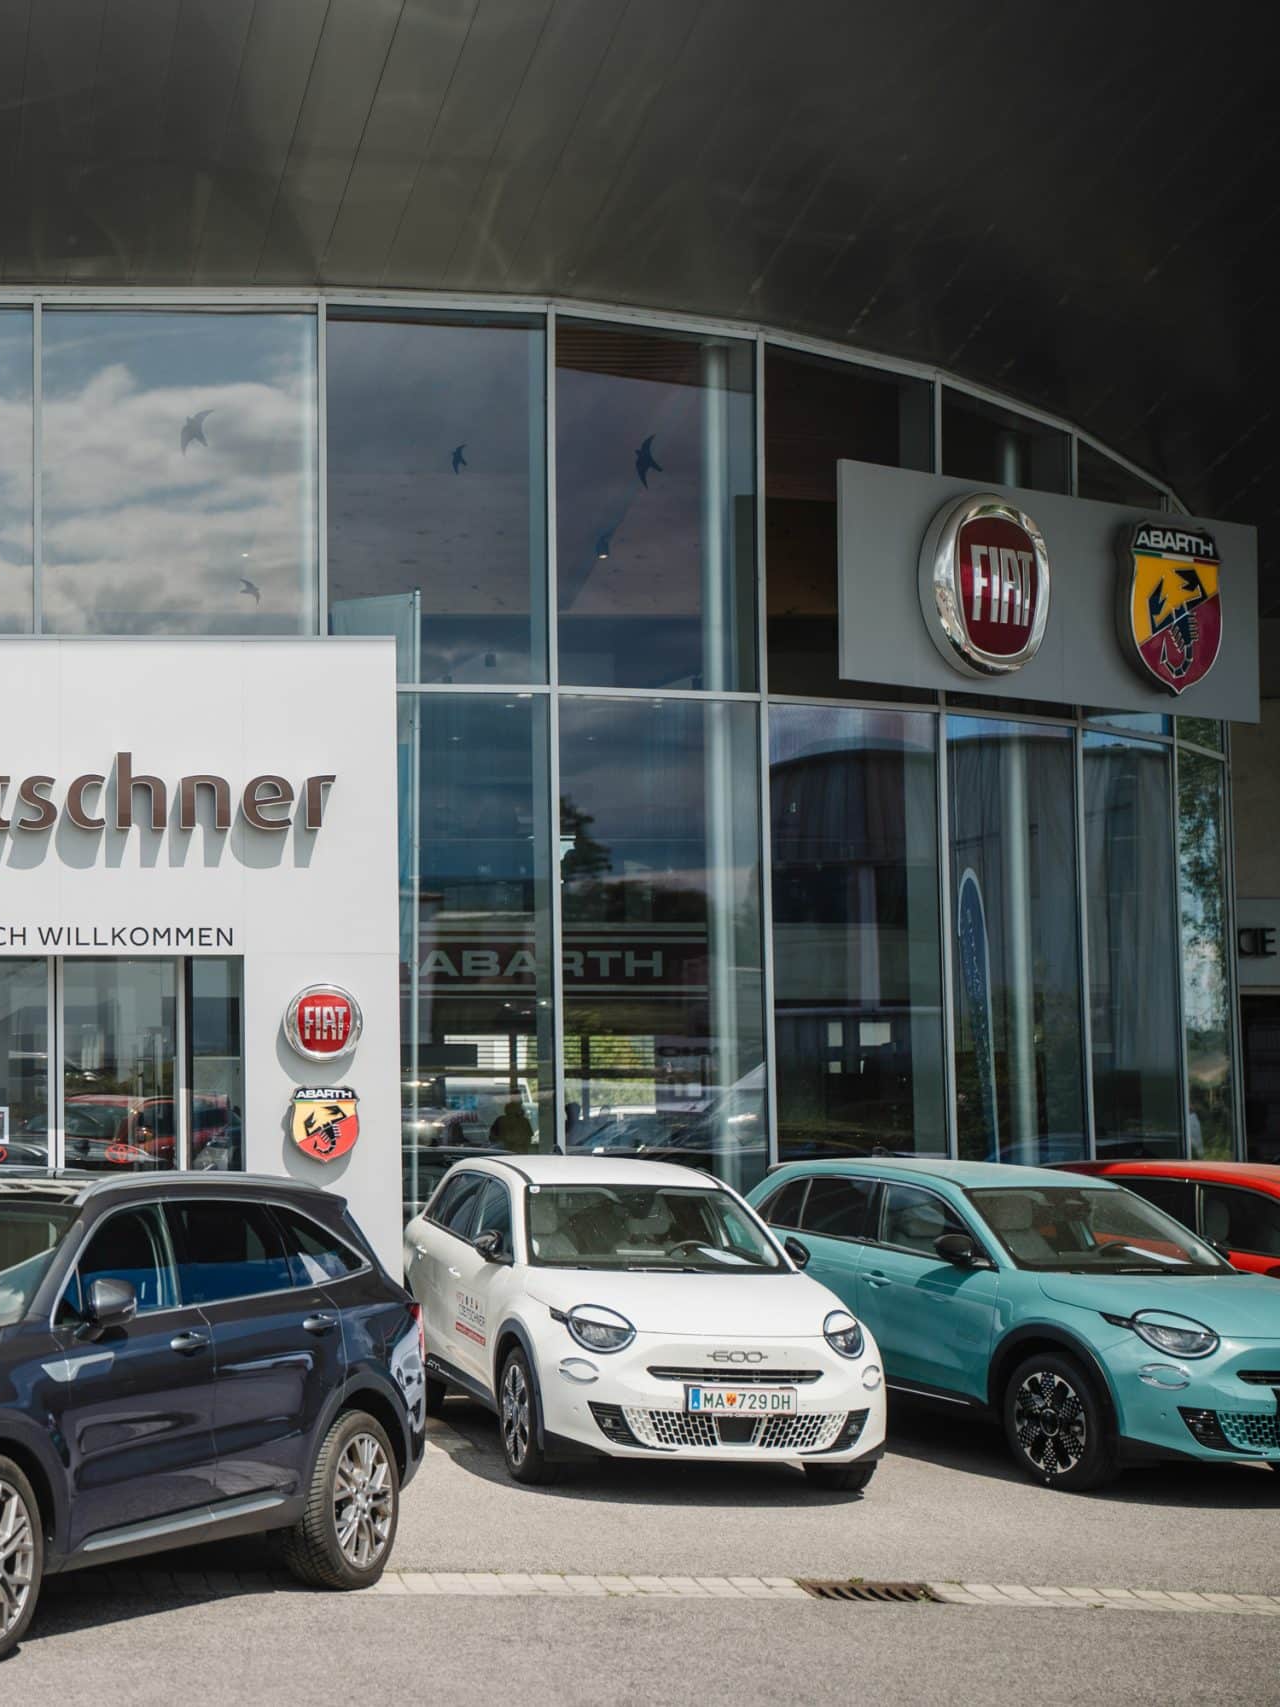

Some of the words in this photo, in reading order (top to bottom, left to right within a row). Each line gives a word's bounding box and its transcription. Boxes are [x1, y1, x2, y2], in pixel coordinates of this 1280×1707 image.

[1136, 530, 1214, 556] ABARTH
[970, 544, 1034, 627] FIAT
[38, 926, 235, 947] WILLKOMMEN
[419, 951, 663, 977] ABARTH
[304, 1006, 348, 1041] FIAT
[296, 1089, 352, 1099] ABARTH
[703, 1393, 725, 1409] MA
[738, 1393, 768, 1410] 729
[771, 1394, 791, 1410] DH
